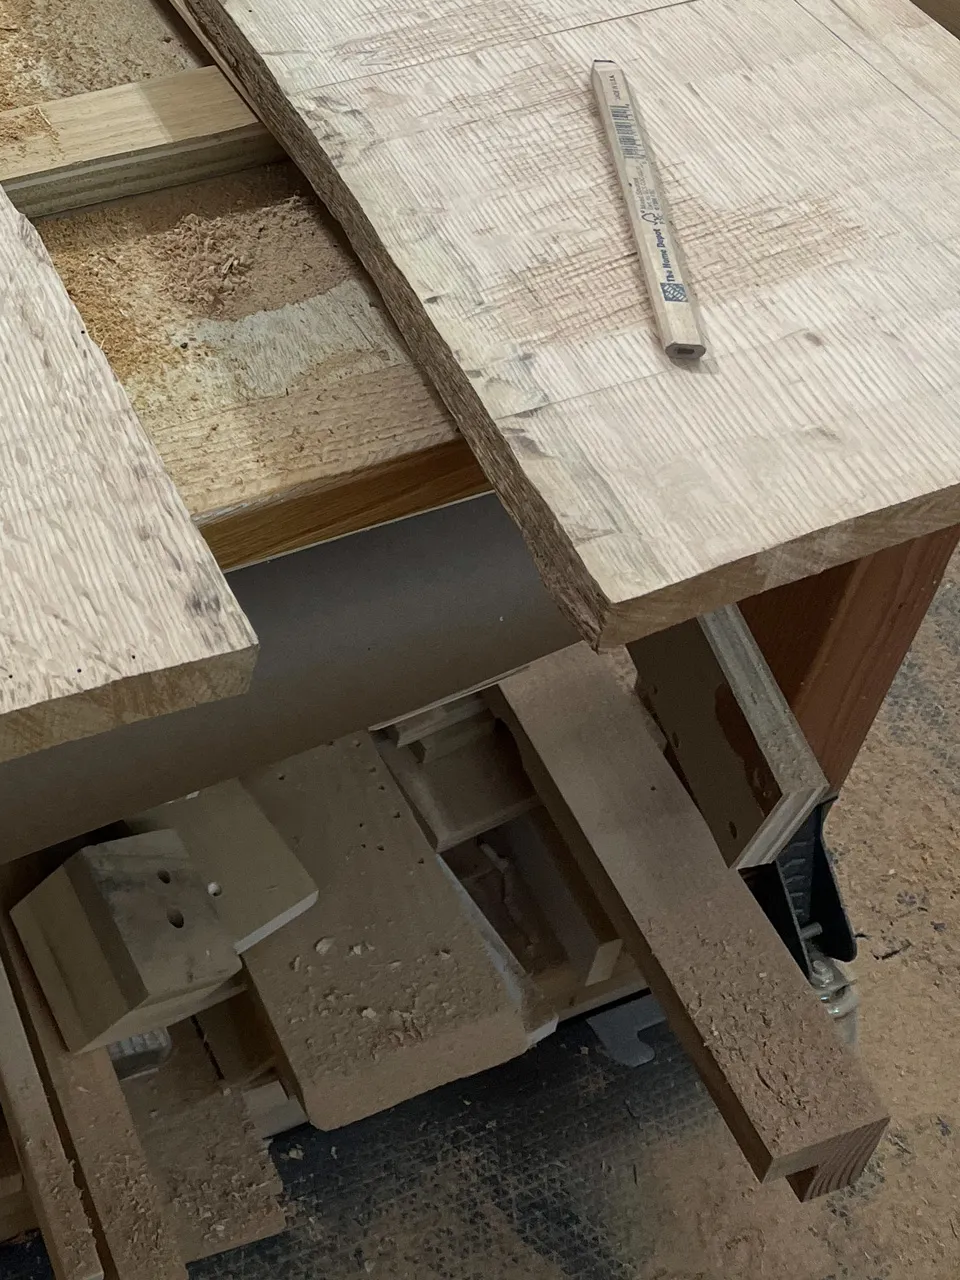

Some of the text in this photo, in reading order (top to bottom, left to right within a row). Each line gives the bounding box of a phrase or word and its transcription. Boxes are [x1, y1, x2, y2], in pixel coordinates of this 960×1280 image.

[653, 228, 666, 248] Depot
[660, 249, 672, 268] Home
[666, 270, 676, 282] The
